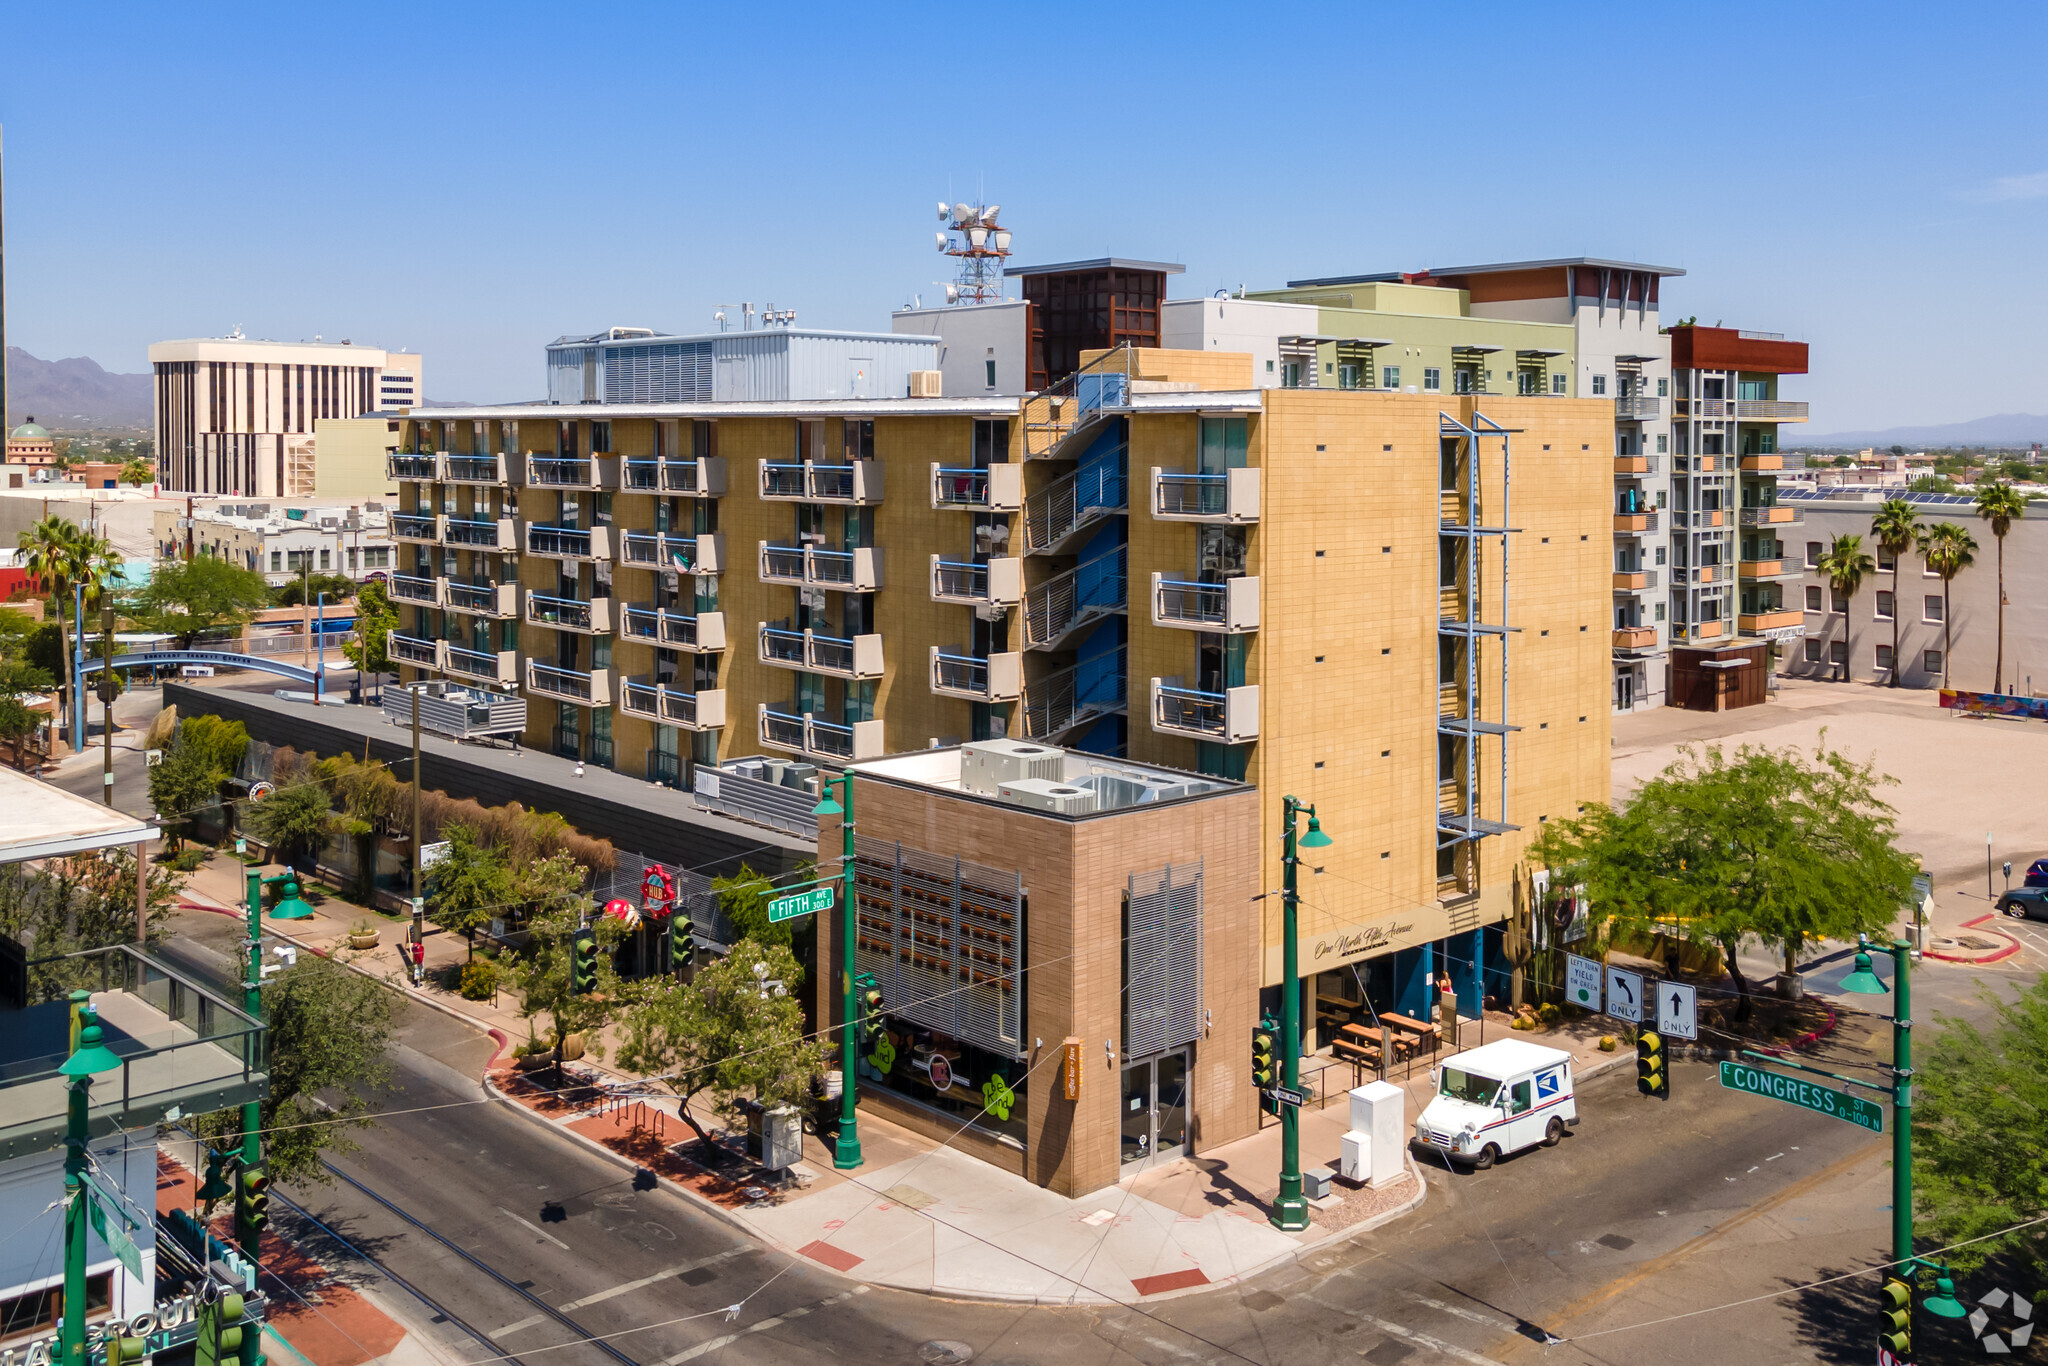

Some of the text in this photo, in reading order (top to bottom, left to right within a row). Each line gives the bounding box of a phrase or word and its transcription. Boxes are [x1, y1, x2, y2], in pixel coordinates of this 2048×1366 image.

[648, 885, 663, 900] HUB
[816, 891, 827, 899] AVE
[771, 896, 809, 917] N FIFTH
[813, 898, 831, 910] 300 E
[1314, 922, 1414, 960] One North Fifth Avenue
[1570, 957, 1599, 973] LEFT TURN
[1574, 968, 1594, 981] YIELD
[1570, 977, 1598, 992] ON GREEN
[1611, 1003, 1637, 1018] ONLY
[1663, 1020, 1691, 1034] ONLY
[1068, 1047, 1077, 1062] fare
[991, 1082, 1004, 1093] be
[1068, 1077, 1076, 1097] coffee
[1723, 1063, 1835, 1112] E CONGRESS
[987, 1089, 1009, 1109] kind
[1853, 1099, 1865, 1112] ST
[1839, 1106, 1880, 1131] 0-100 N
